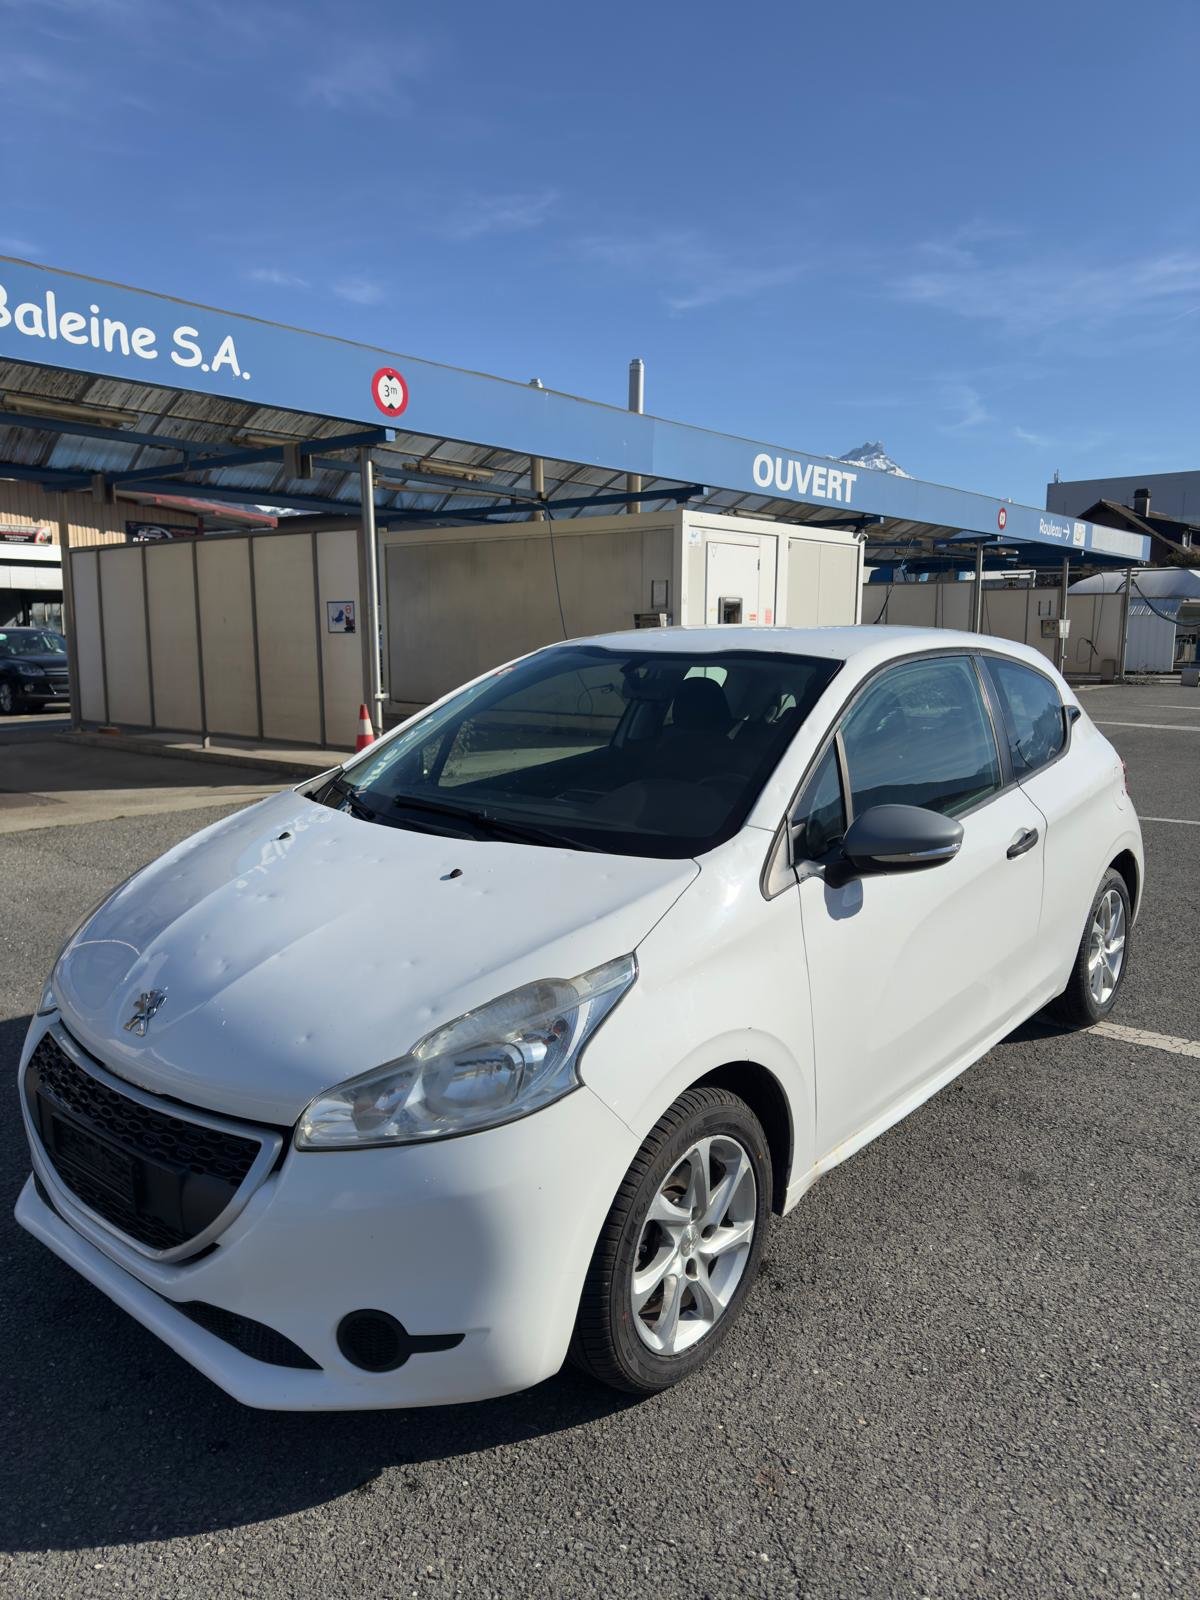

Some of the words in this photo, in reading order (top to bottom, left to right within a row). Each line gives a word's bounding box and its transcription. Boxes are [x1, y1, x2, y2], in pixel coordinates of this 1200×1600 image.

[170, 325, 250, 380] S.A.
[752, 453, 857, 504] OUVERT
[1039, 518, 1063, 538] Rouleau
